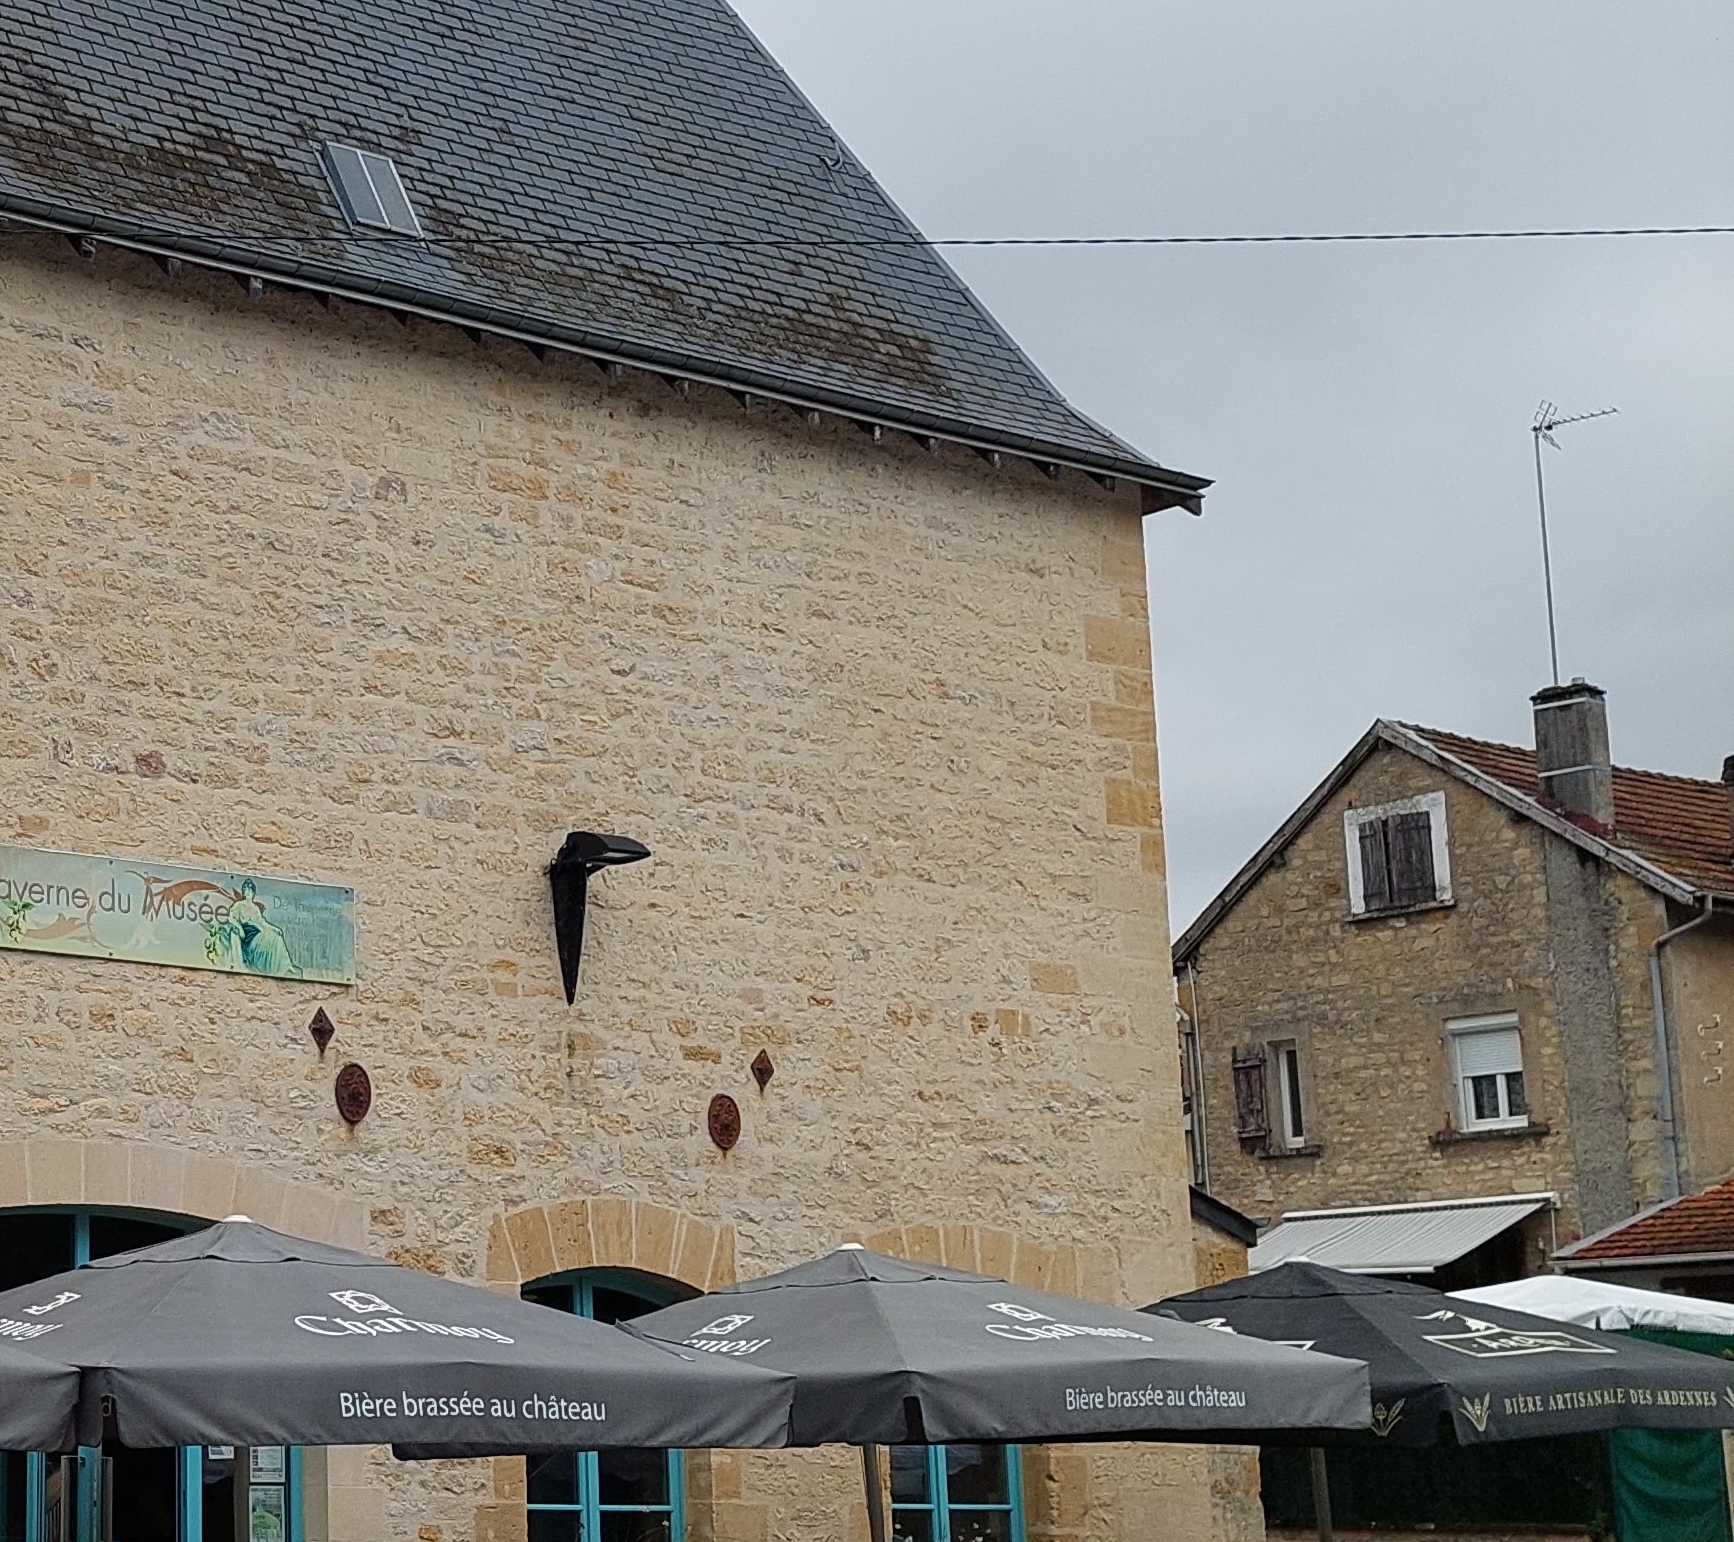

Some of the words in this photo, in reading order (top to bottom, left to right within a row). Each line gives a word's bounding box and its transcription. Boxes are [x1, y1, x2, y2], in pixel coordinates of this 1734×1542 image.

[98, 877, 131, 914] du
[142, 885, 231, 925] Musée
[294, 1314, 515, 1344] Charmoy
[339, 1391, 397, 1418] Bière
[402, 1390, 485, 1417] brassée
[489, 1398, 516, 1419] au
[522, 1392, 606, 1422] château
[1065, 1387, 1105, 1410] Bière
[1107, 1384, 1164, 1408] brassée
[1166, 1389, 1185, 1407] au
[1188, 1384, 1246, 1408] château
[1503, 1393, 1544, 1415] BIÈRE
[1548, 1388, 1626, 1411] ARTISANALE
[1629, 1388, 1653, 1406] DES
[1656, 1390, 1718, 1407] ARDENNES
